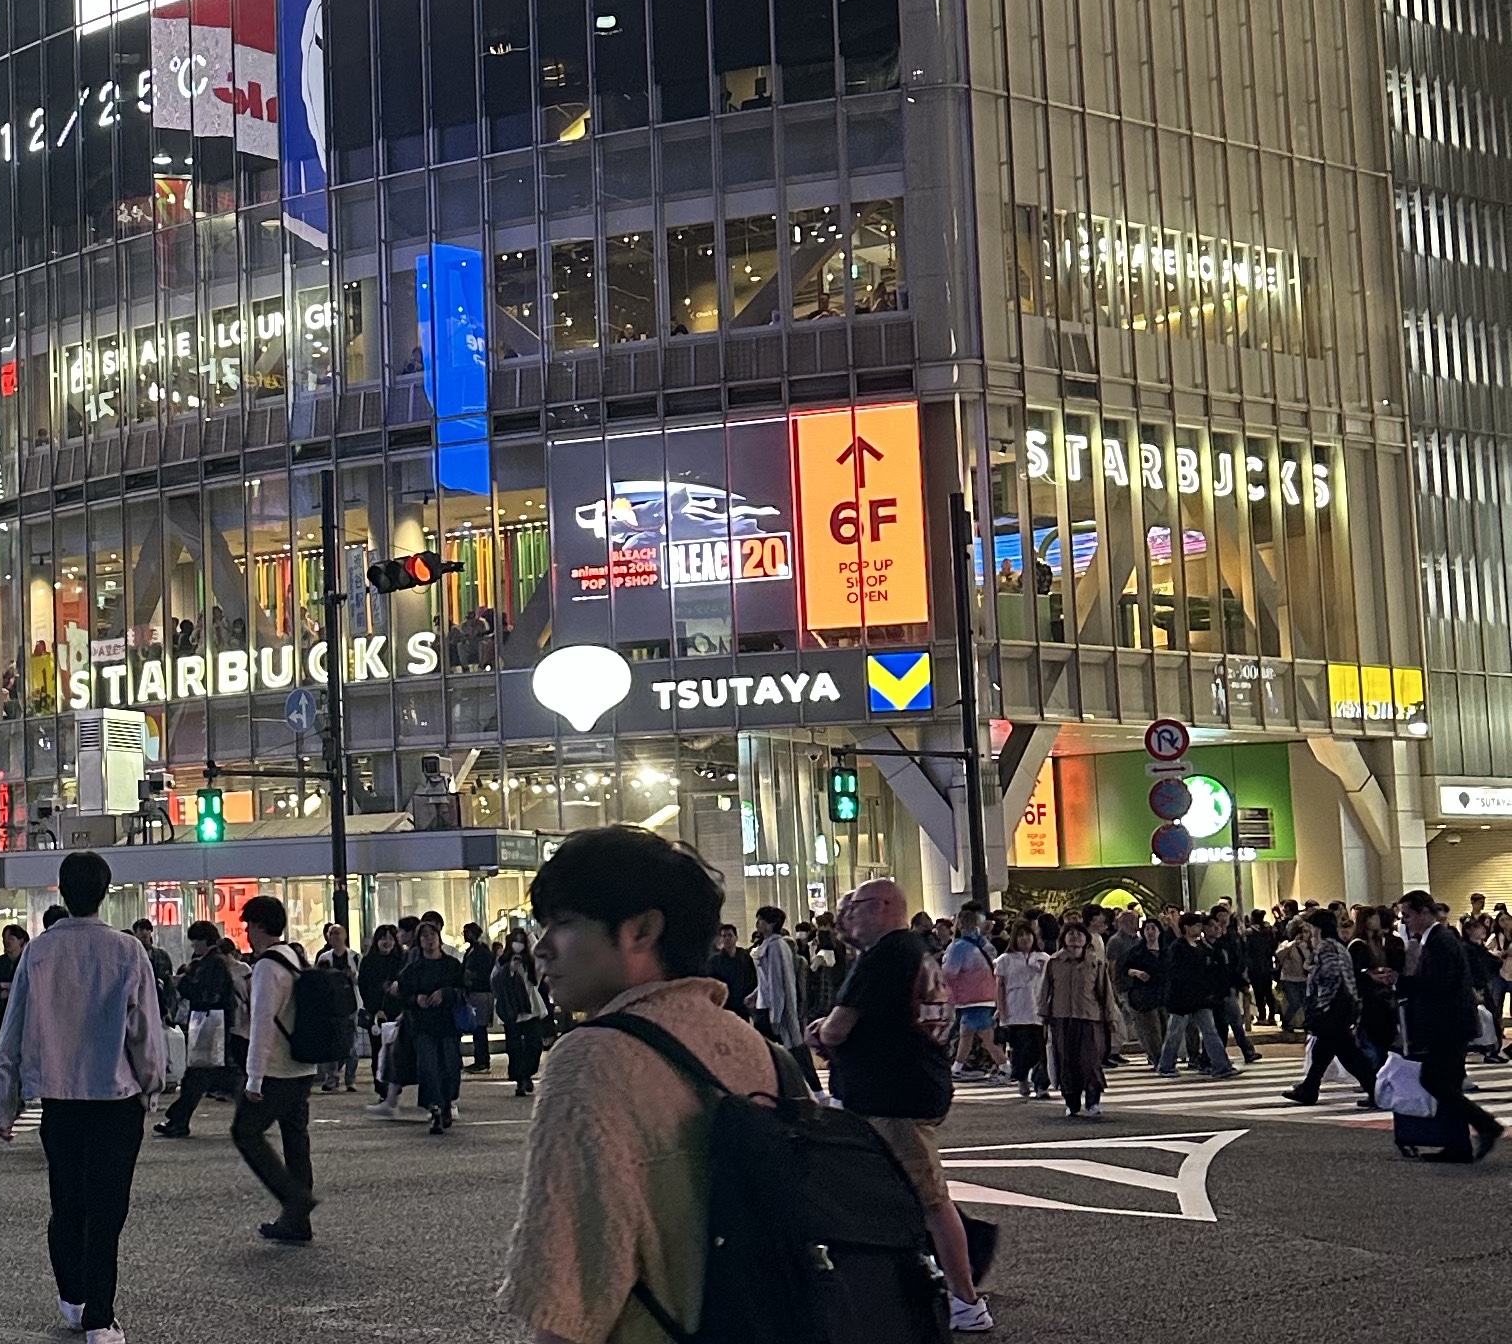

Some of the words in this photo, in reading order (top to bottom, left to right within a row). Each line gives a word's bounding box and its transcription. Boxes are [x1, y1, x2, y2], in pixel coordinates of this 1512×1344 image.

[1025, 429, 1330, 508] STARBUCKS
[830, 498, 897, 545] 6F
[611, 547, 656, 561] BLEACH
[629, 563, 657, 574] 20th
[839, 561, 869, 573] POP
[874, 559, 893, 571] UP
[581, 579, 606, 591] POP
[625, 574, 657, 589] SHOP
[847, 590, 888, 604] OEN
[69, 630, 438, 709] STARBUCKS
[652, 673, 841, 711] TSUTAYA
[1025, 804, 1046, 825] 6F
